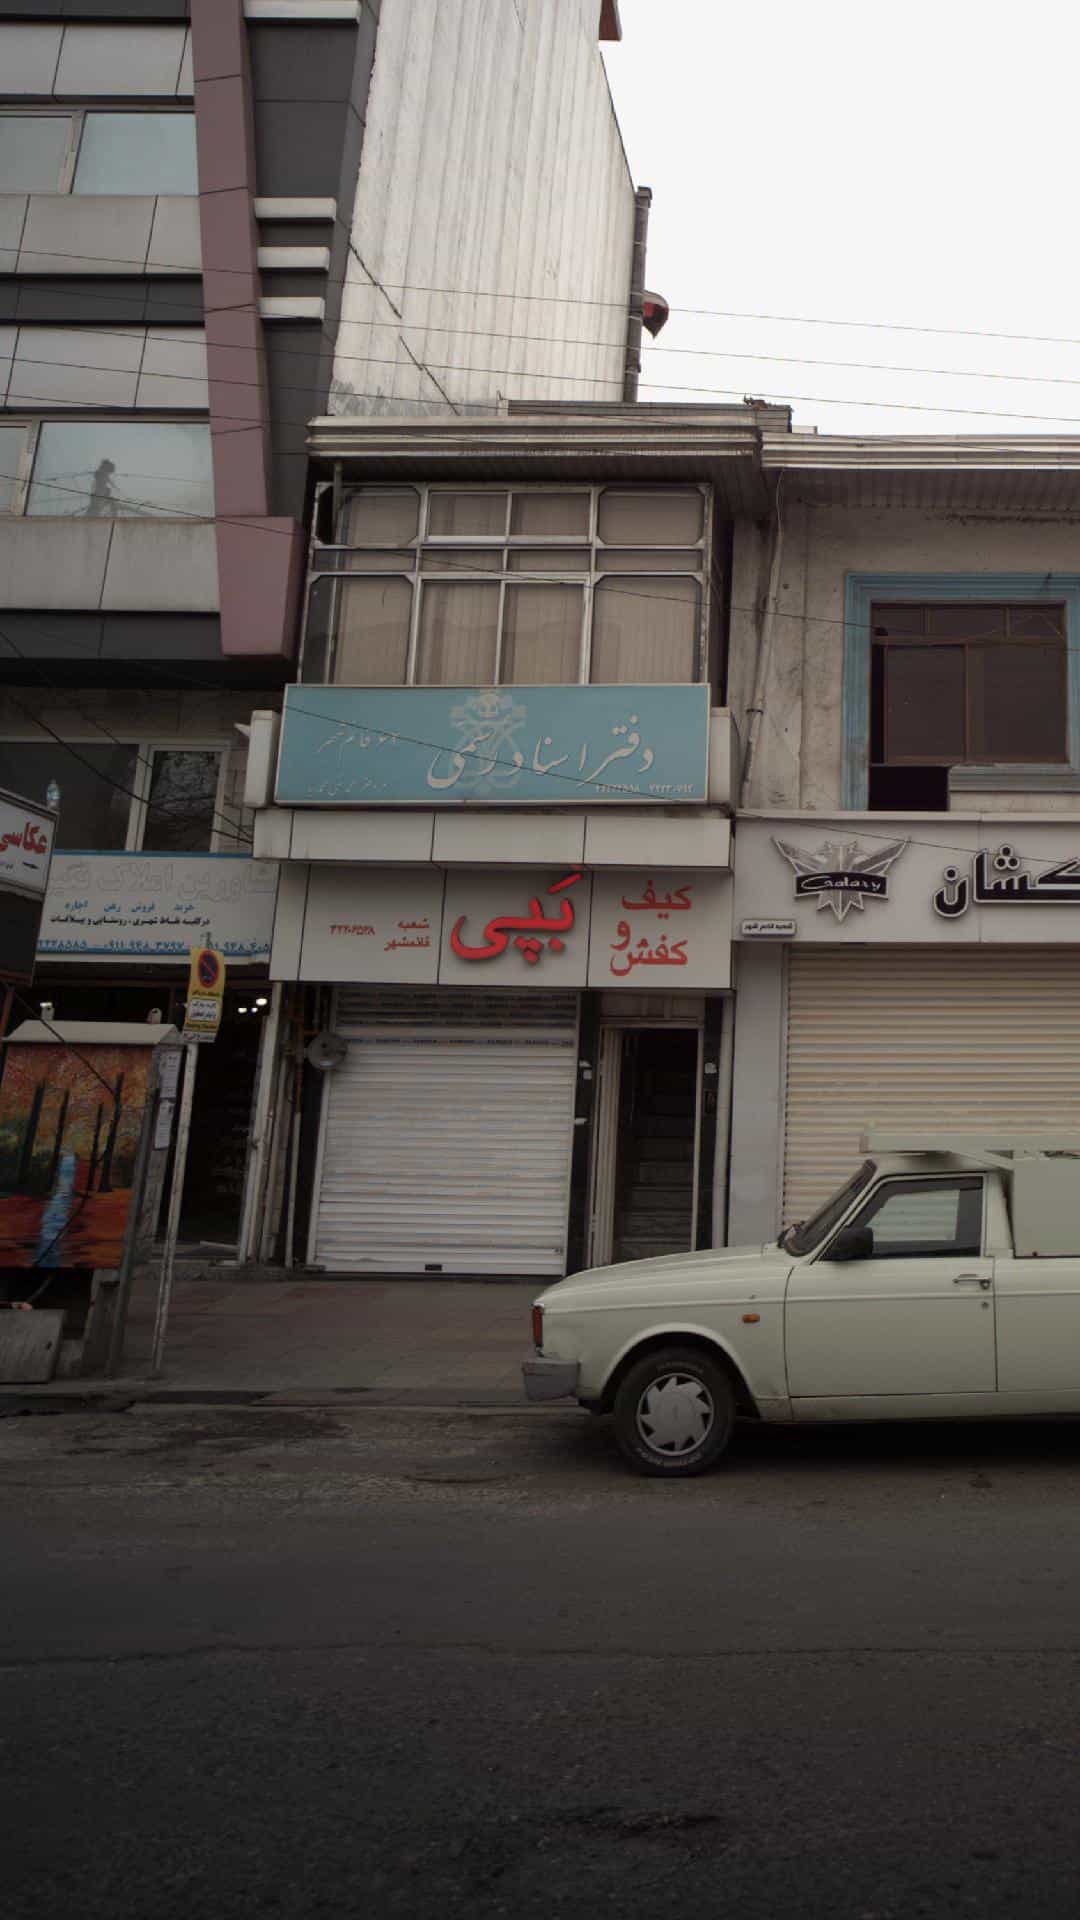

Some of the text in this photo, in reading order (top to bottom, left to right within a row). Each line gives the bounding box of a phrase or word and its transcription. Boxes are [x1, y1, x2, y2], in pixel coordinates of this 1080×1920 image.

[621, 879, 694, 920] کیف
[608, 919, 631, 952] و
[608, 933, 688, 977] کفش
